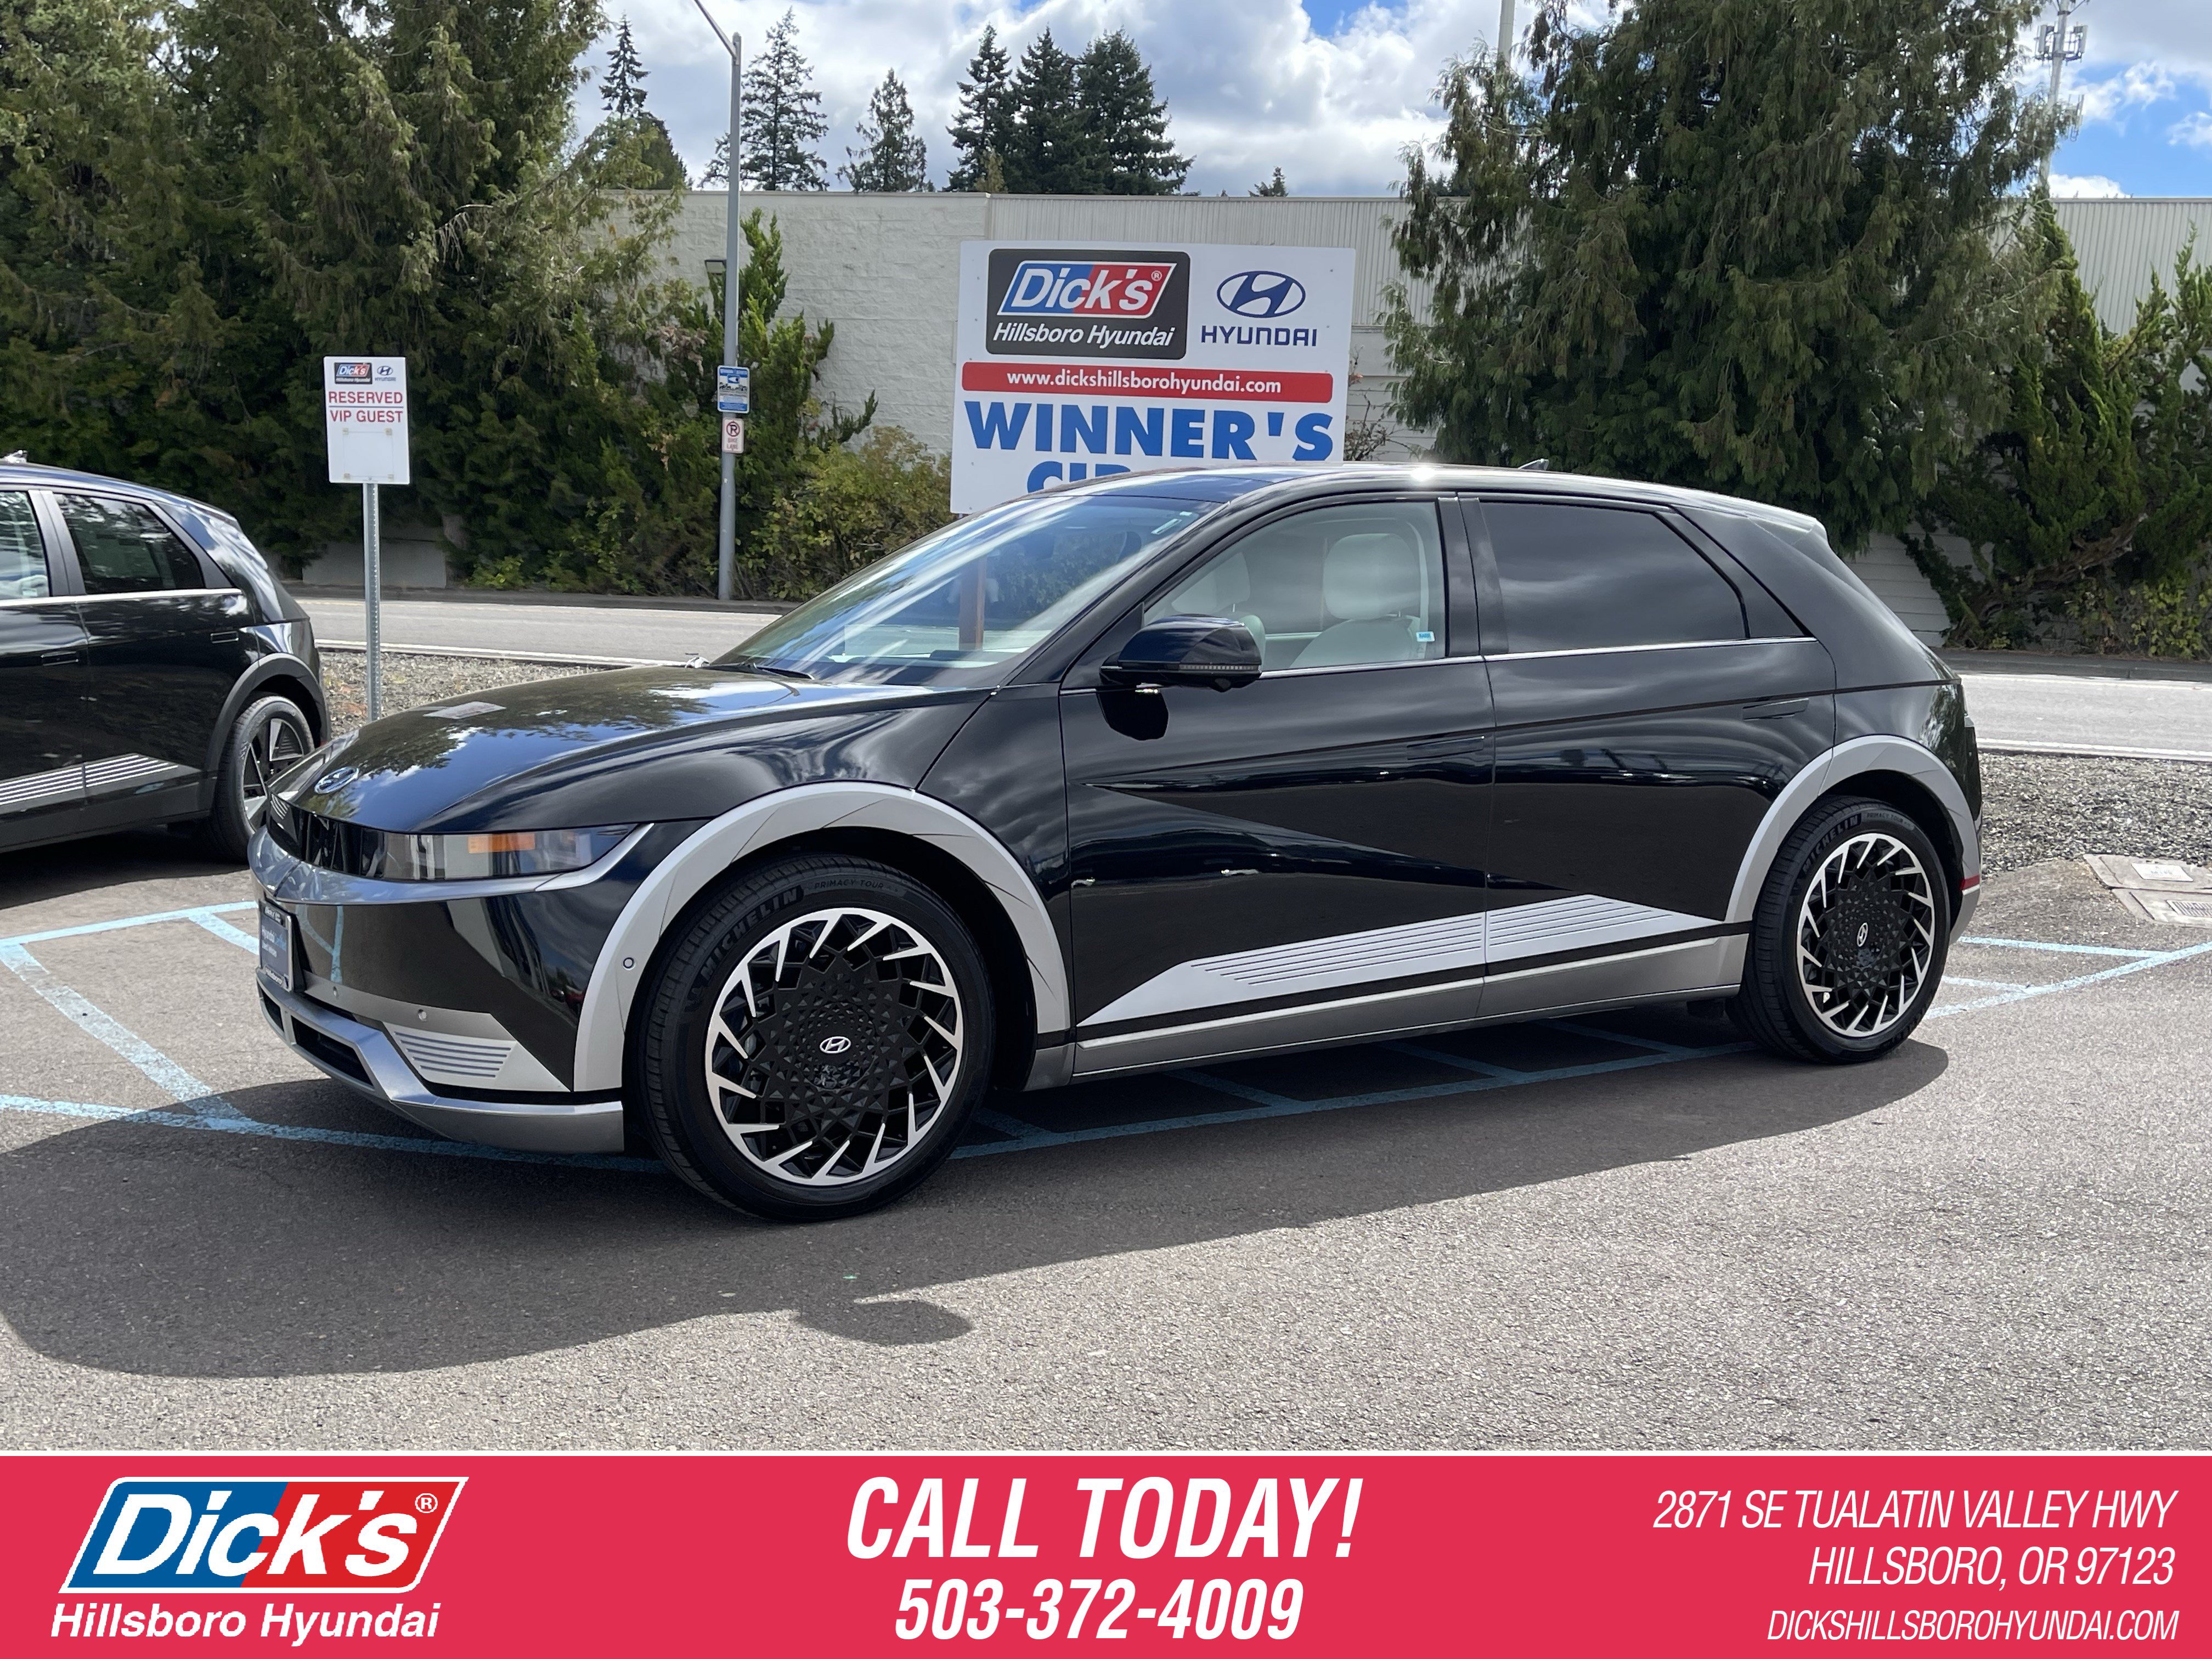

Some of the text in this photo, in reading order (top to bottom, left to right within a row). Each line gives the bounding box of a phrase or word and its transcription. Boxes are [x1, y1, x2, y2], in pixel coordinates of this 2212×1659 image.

[993, 322, 1176, 349] Hillsboro Hyundai
[1201, 325, 1317, 347] HYUNDAI
[1007, 368, 1281, 395] www.dickshillsborohyundai.com
[329, 391, 403, 404] RESERVED
[330, 410, 403, 423] VIP GUEST
[964, 401, 1333, 461] WINNER'S
[1803, 814, 1860, 873] MICHELIN
[814, 879, 855, 889] PRIMACY
[860, 879, 884, 889] TOUR
[701, 888, 800, 981] MICHELIN
